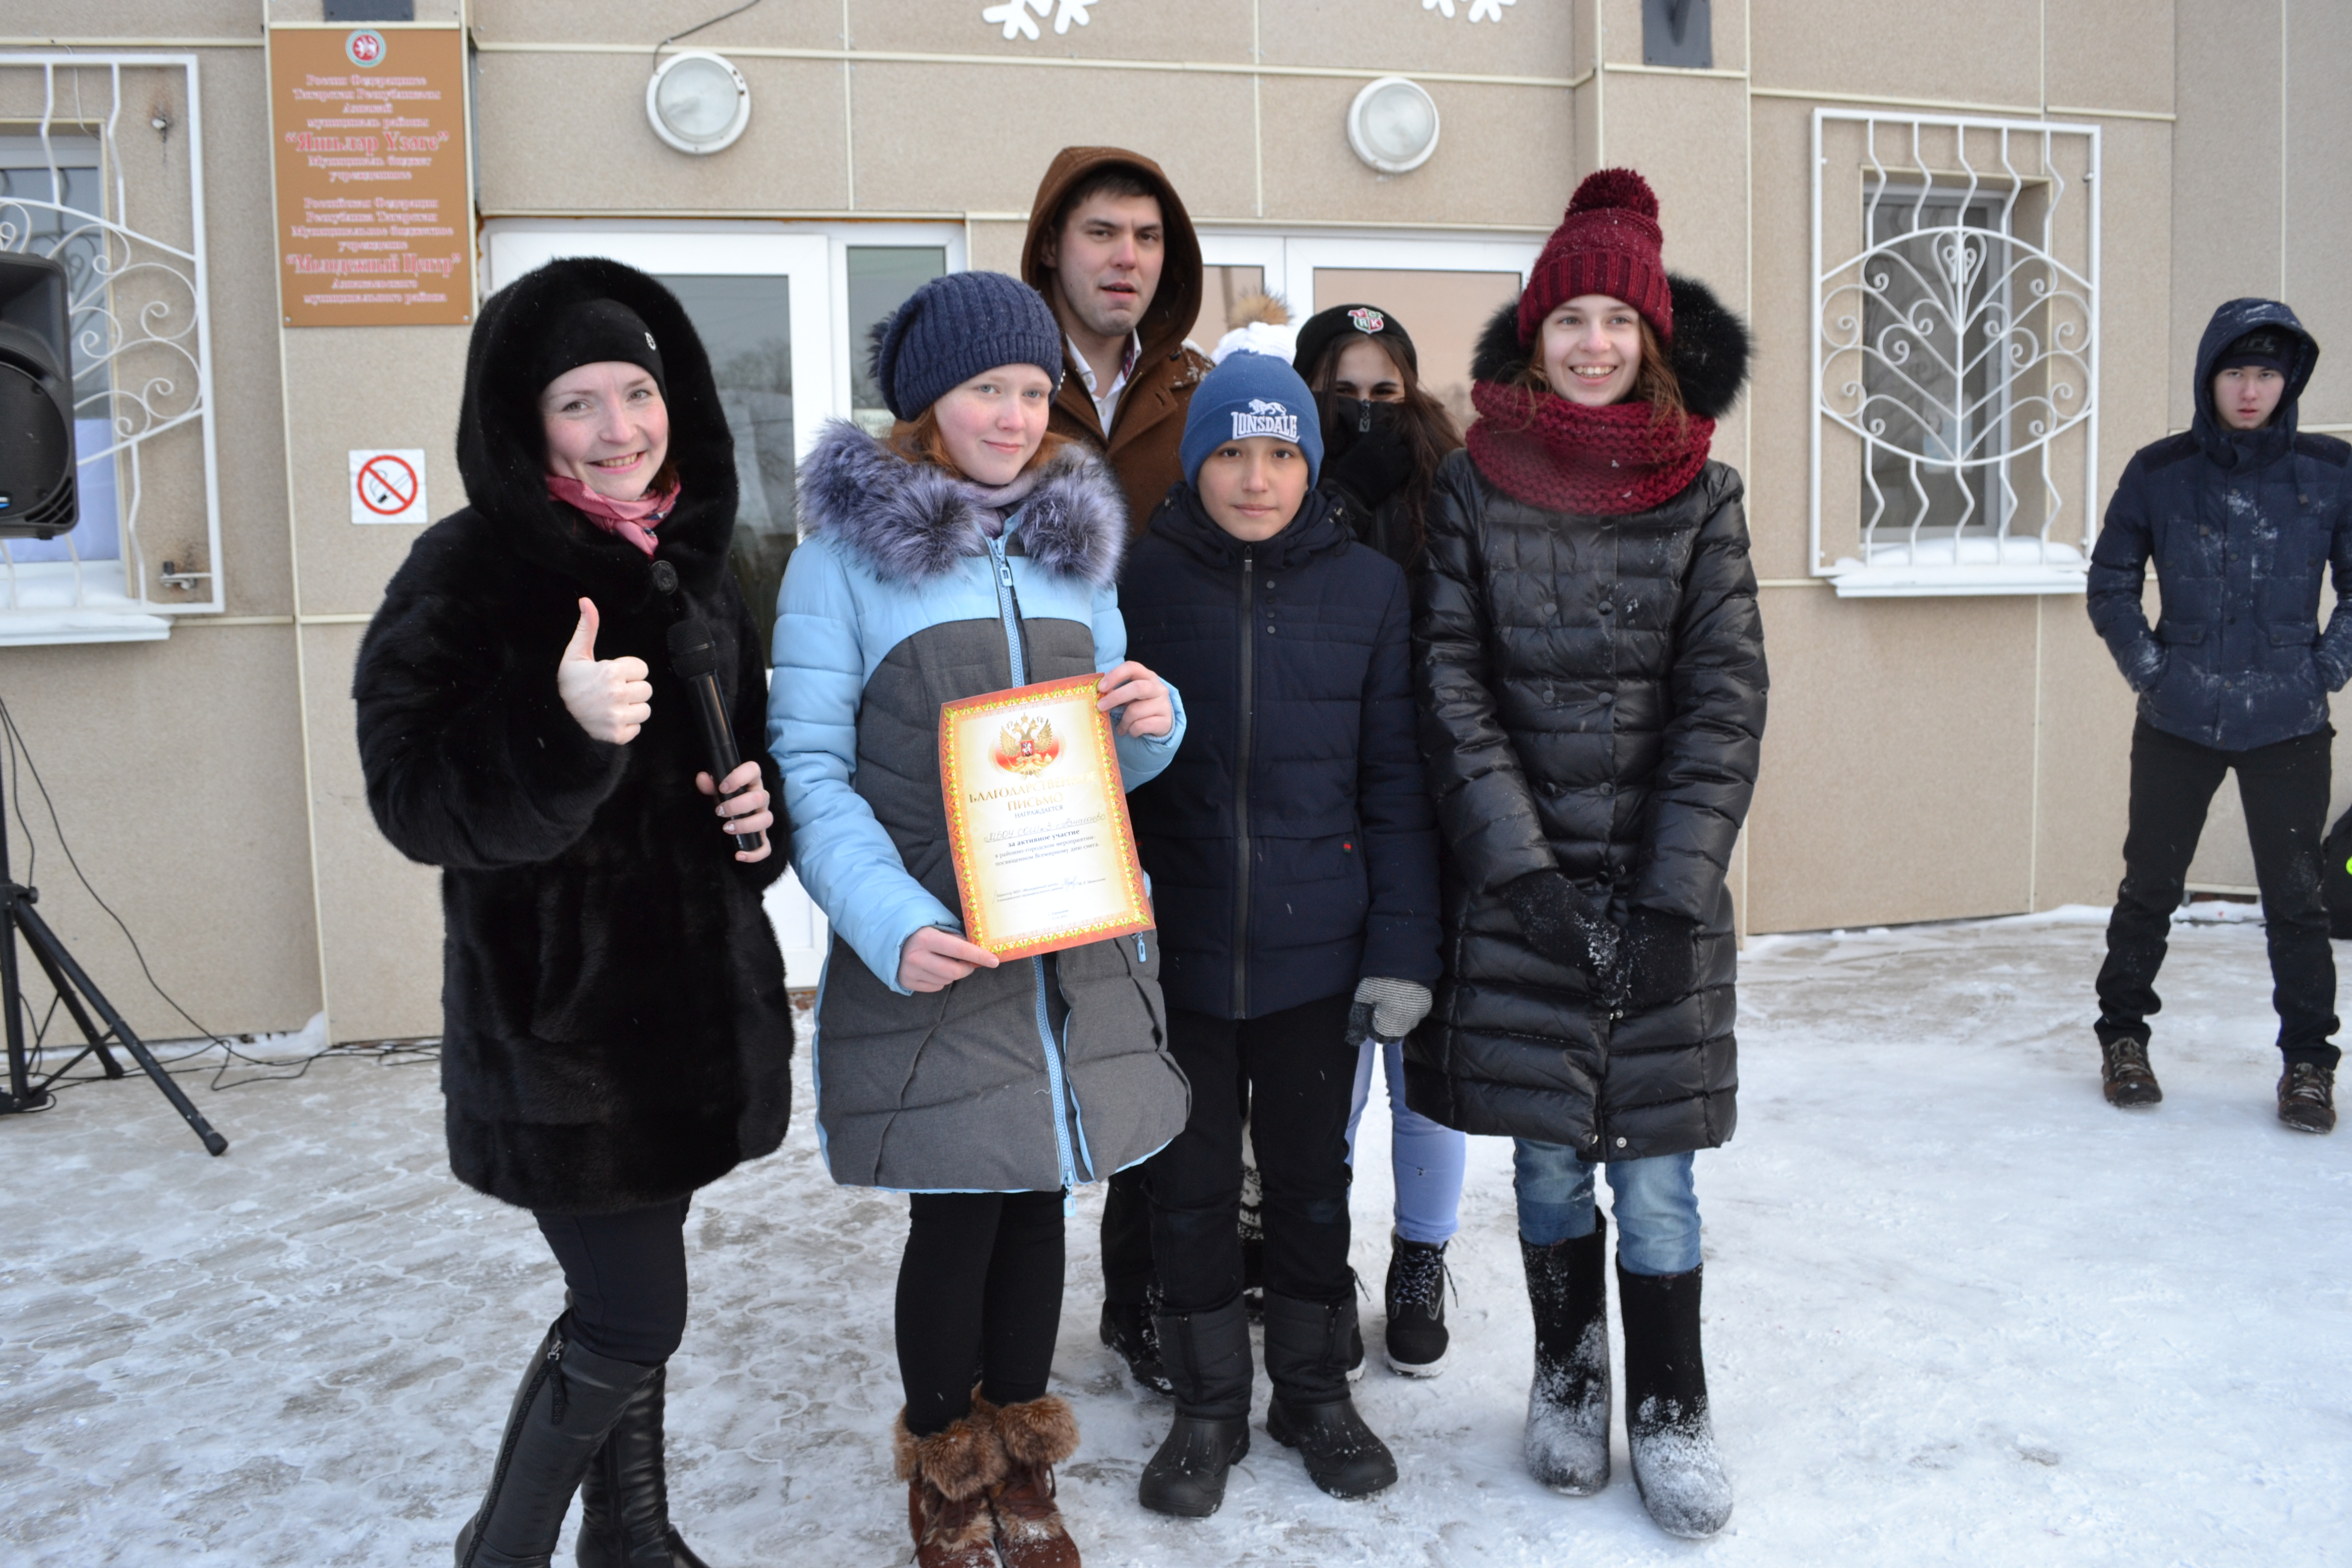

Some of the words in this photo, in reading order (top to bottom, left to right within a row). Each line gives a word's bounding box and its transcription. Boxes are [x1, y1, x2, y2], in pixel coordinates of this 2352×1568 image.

[1231, 411, 1300, 444] LONSDALE
[969, 771, 1097, 803] БЛАГОДАРСТВЕННОЕ
[1008, 792, 1064, 811] ПИСЬМО
[1014, 805, 1063, 818] НАГРАЖДАЕТСЯ
[1017, 835, 1050, 847] активное
[1052, 829, 1080, 840] участие
[995, 855, 1034, 867] посвященном
[1035, 848, 1069, 860] Всемирному
[999, 842, 1055, 859] районно-городском
